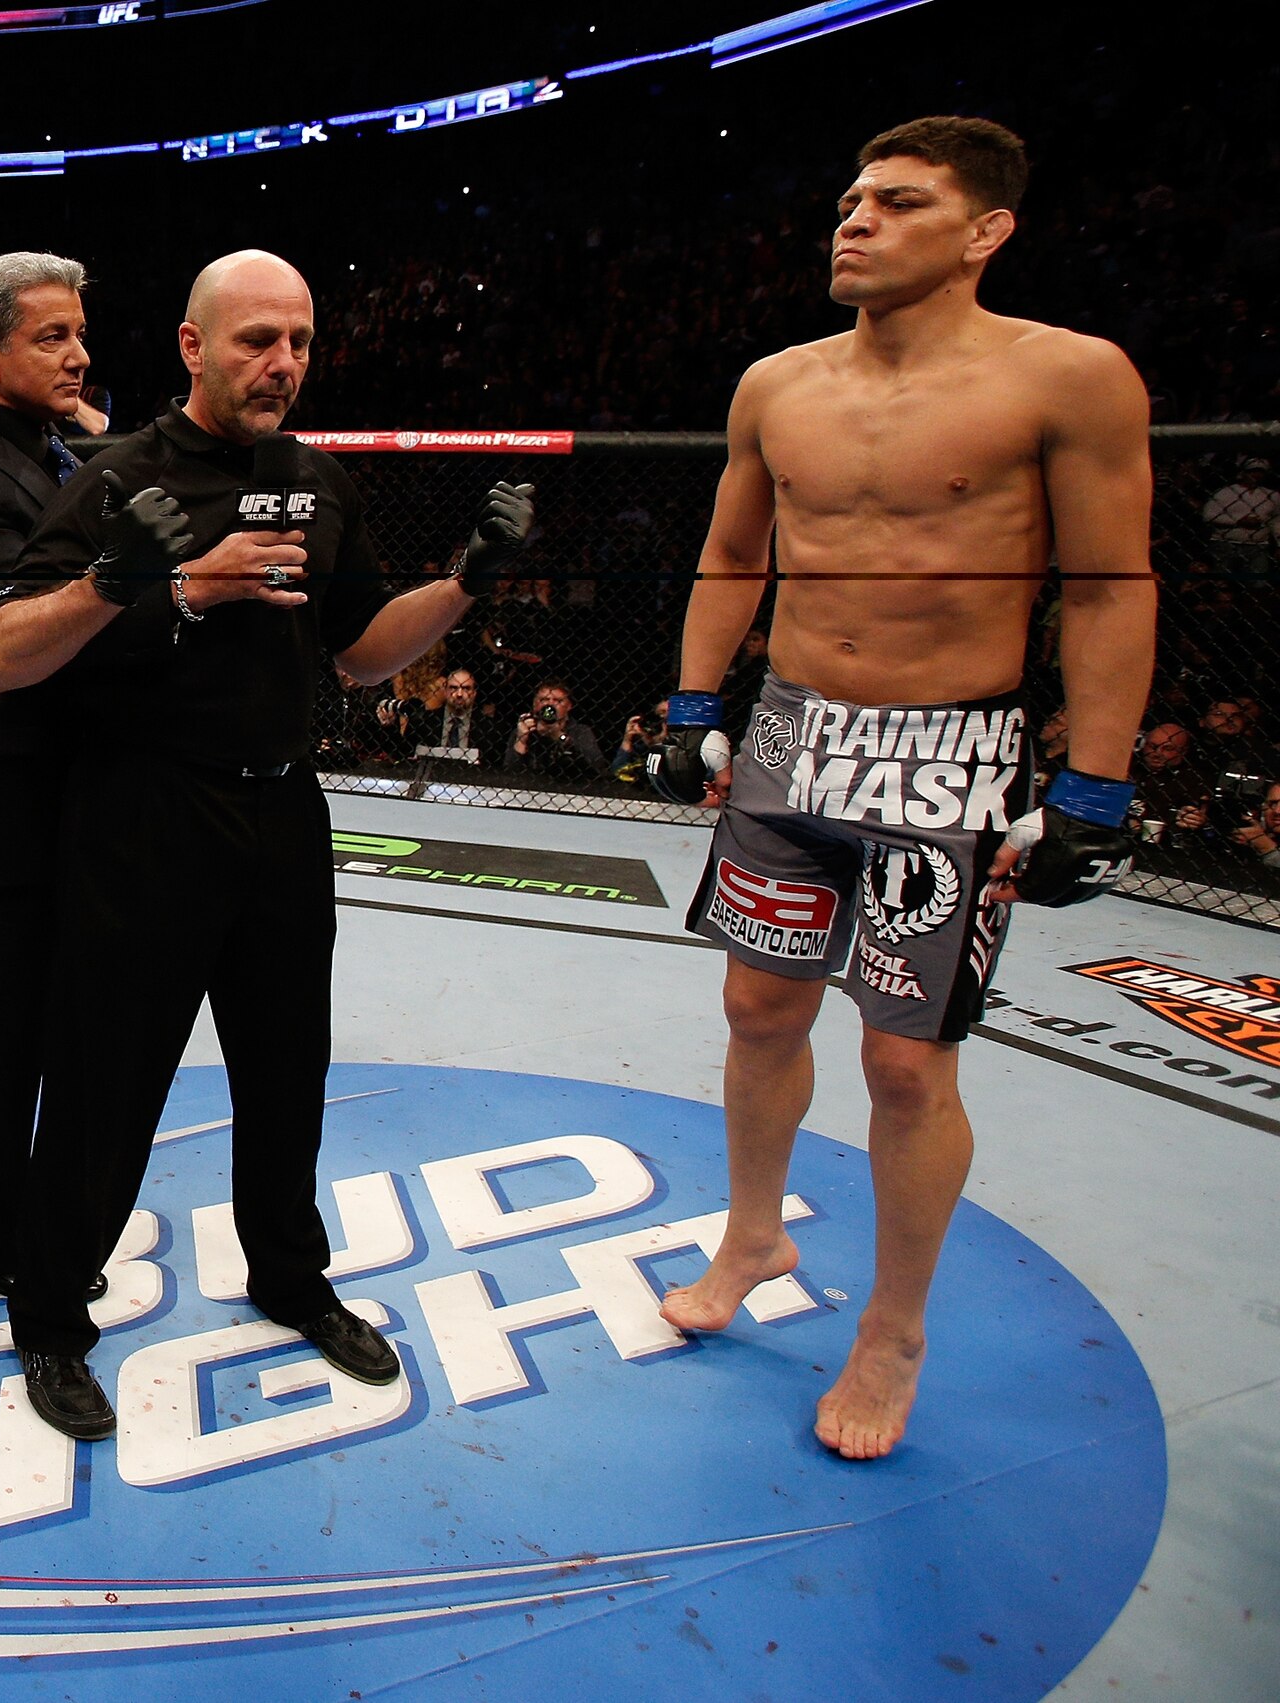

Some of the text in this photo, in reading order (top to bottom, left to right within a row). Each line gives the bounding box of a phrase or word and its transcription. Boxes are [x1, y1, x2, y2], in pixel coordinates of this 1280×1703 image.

[98, 2, 141, 24] UFC
[183, 122, 328, 161] NICK
[324, 433, 376, 445] Pizza
[421, 433, 494, 446] Boston
[491, 434, 549, 447] Pizza
[238, 493, 282, 513] UFC
[286, 492, 316, 512] UFC
[799, 699, 1025, 763] TRAINING
[787, 750, 1018, 832] MASK
[710, 895, 827, 957] SAFEAUTO.COM
